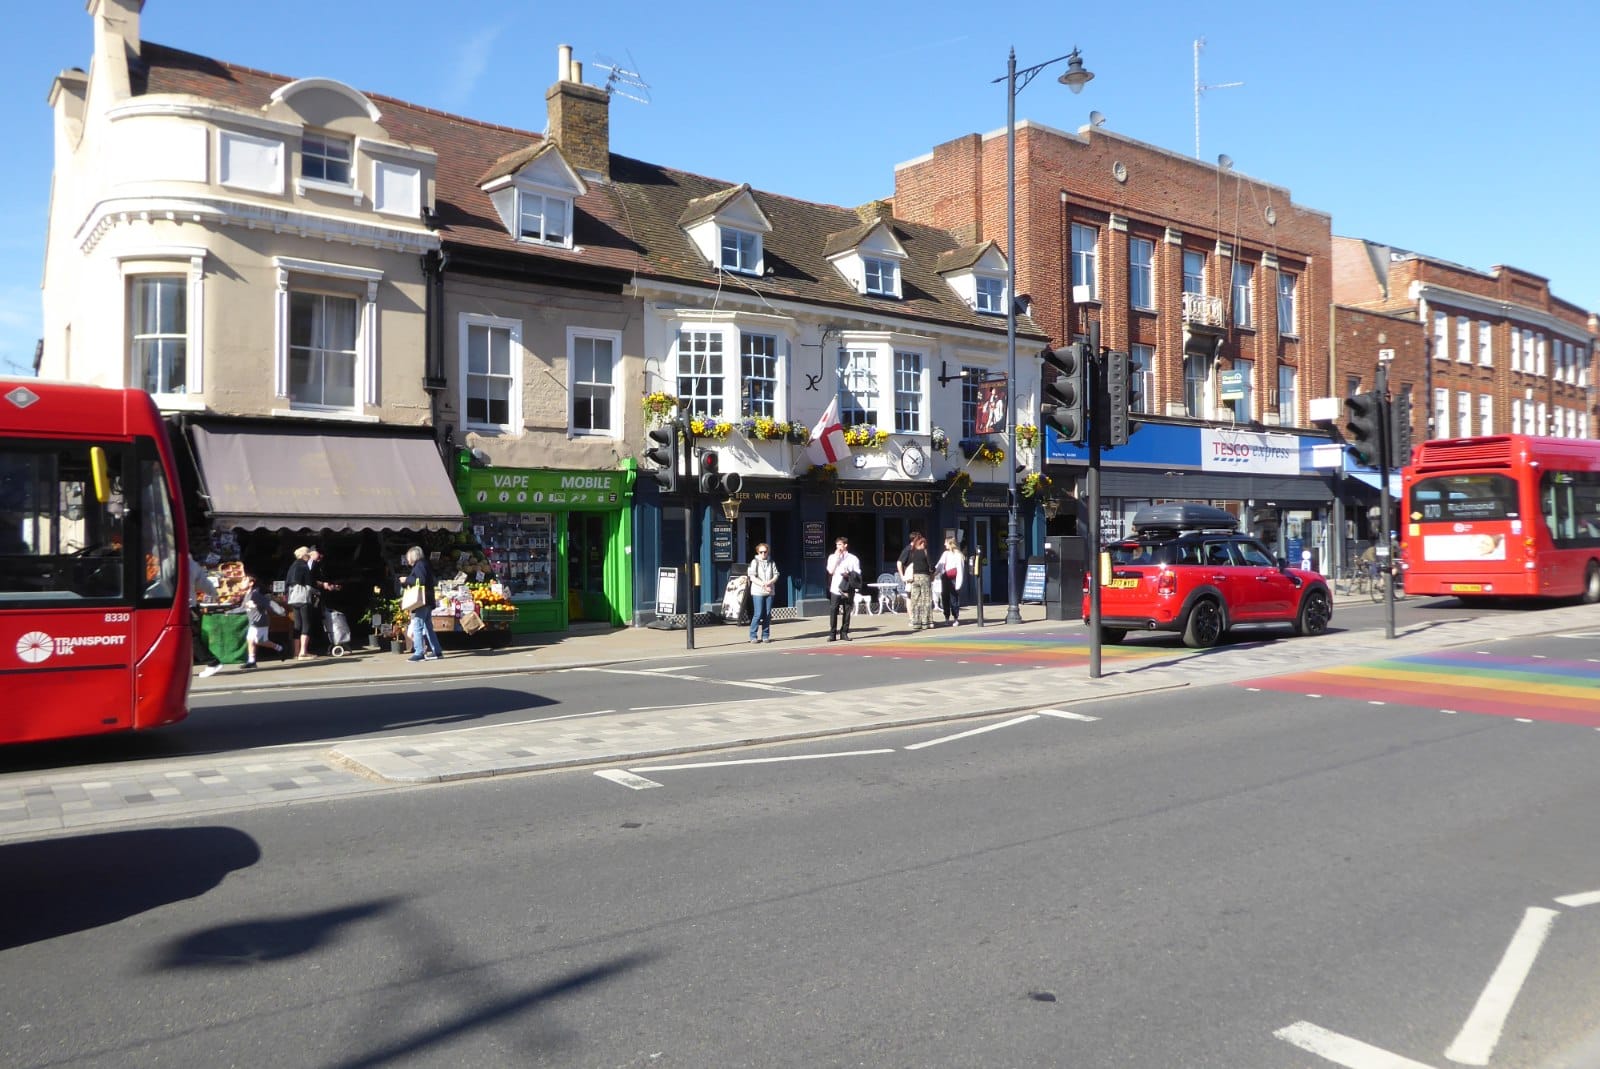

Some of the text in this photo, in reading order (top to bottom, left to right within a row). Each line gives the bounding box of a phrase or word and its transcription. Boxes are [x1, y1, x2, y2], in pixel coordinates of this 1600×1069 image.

[1212, 441, 1290, 462] TESCO express
[493, 475, 611, 489] VAPE MOBILE
[735, 492, 750, 500] BEER
[774, 492, 792, 500] FOOD
[832, 490, 932, 508] THE GEORGE
[104, 613, 130, 622] 8330
[54, 635, 126, 646] TRANSPORT
[56, 645, 74, 655] UK
